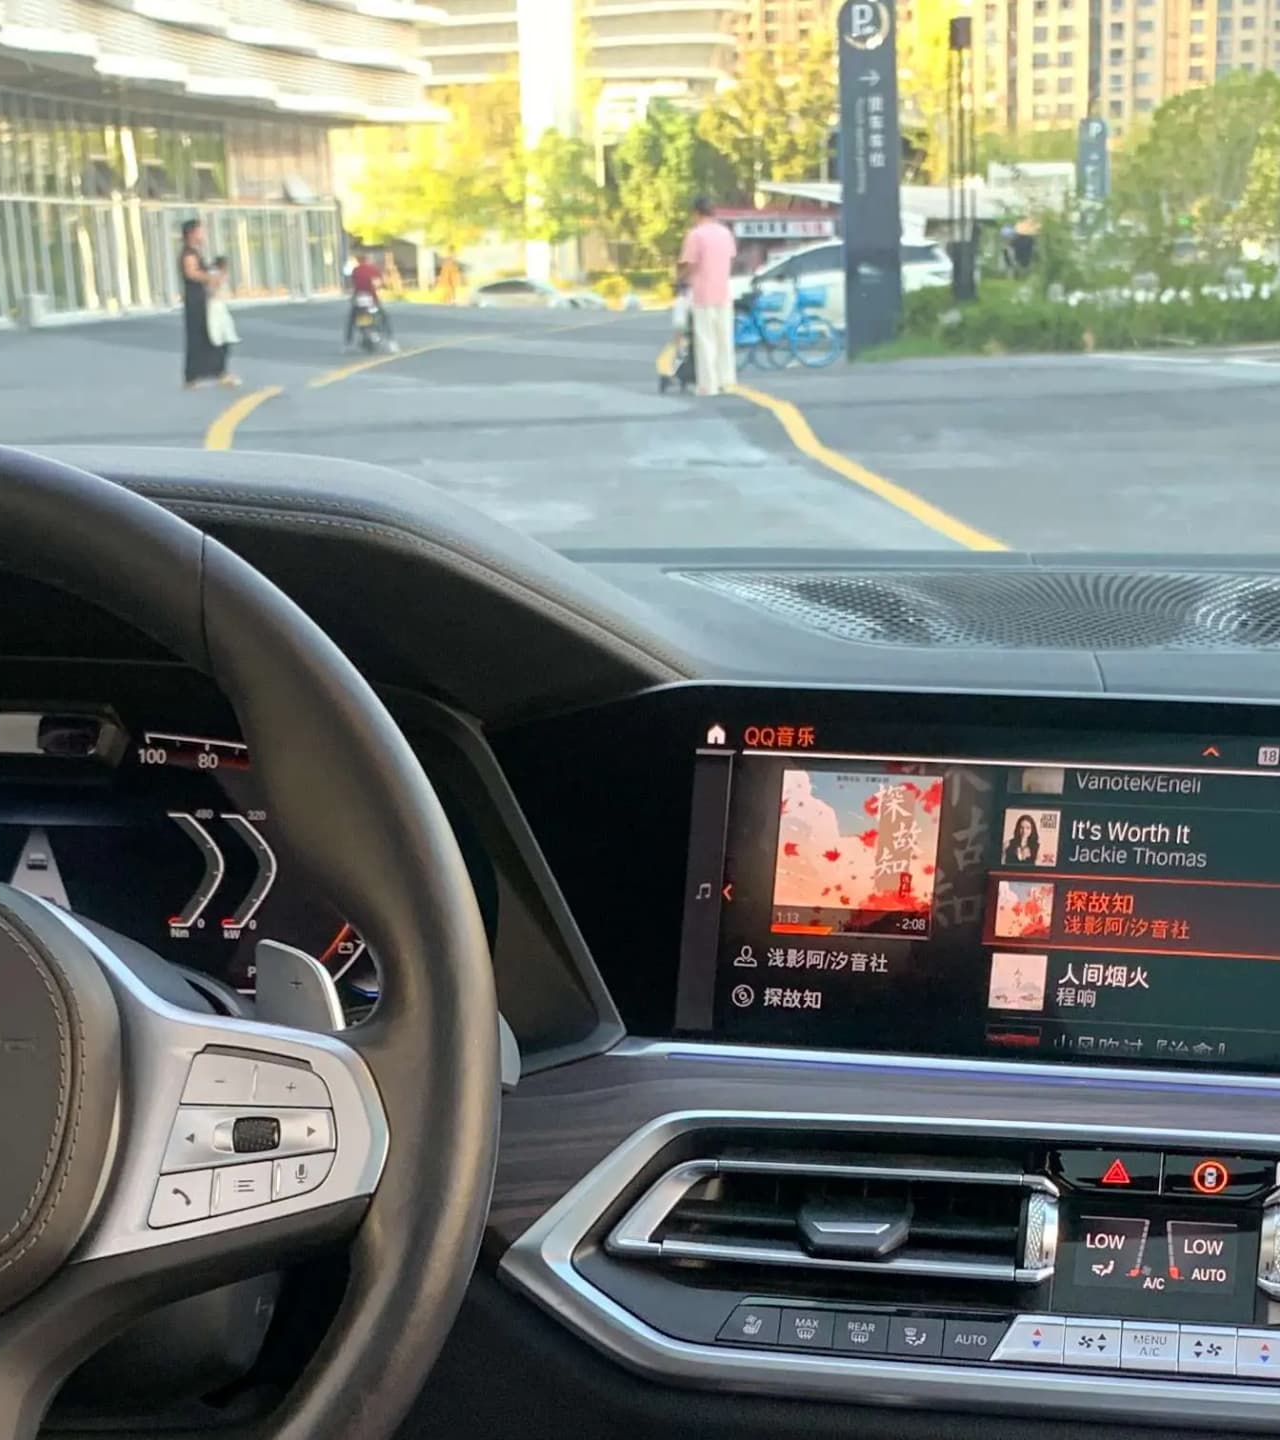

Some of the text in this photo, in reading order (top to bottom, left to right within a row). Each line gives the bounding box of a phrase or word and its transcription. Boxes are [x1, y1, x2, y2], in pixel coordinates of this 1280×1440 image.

[744, 726, 816, 747] QQ音乐
[138, 748, 167, 765] 100
[197, 753, 218, 769] 80
[1071, 820, 1102, 841] It's
[1108, 822, 1170, 843] Worth
[1176, 824, 1191, 845] It
[1069, 845, 1128, 864] Jackie
[1132, 847, 1208, 868] Thomas
[1065, 891, 1134, 914] 探故知
[776, 912, 800, 924] 1:13
[1063, 916, 1190, 940] 浅影阿/汐音社
[767, 948, 889, 973] 浅影阿/汐音社
[1057, 963, 1150, 989] 人间烟火
[762, 988, 822, 1009] 探故知
[1055, 987, 1097, 1009] 程响
[1086, 1233, 1125, 1251] LOW
[1184, 1239, 1223, 1257] LOW
[1143, 1277, 1166, 1291] A/C
[1191, 1268, 1227, 1283] AUTO
[795, 1317, 819, 1329] MAX
[848, 1322, 875, 1333] REAR
[954, 1334, 988, 1346] AUTO
[1133, 1334, 1168, 1346] MENU
